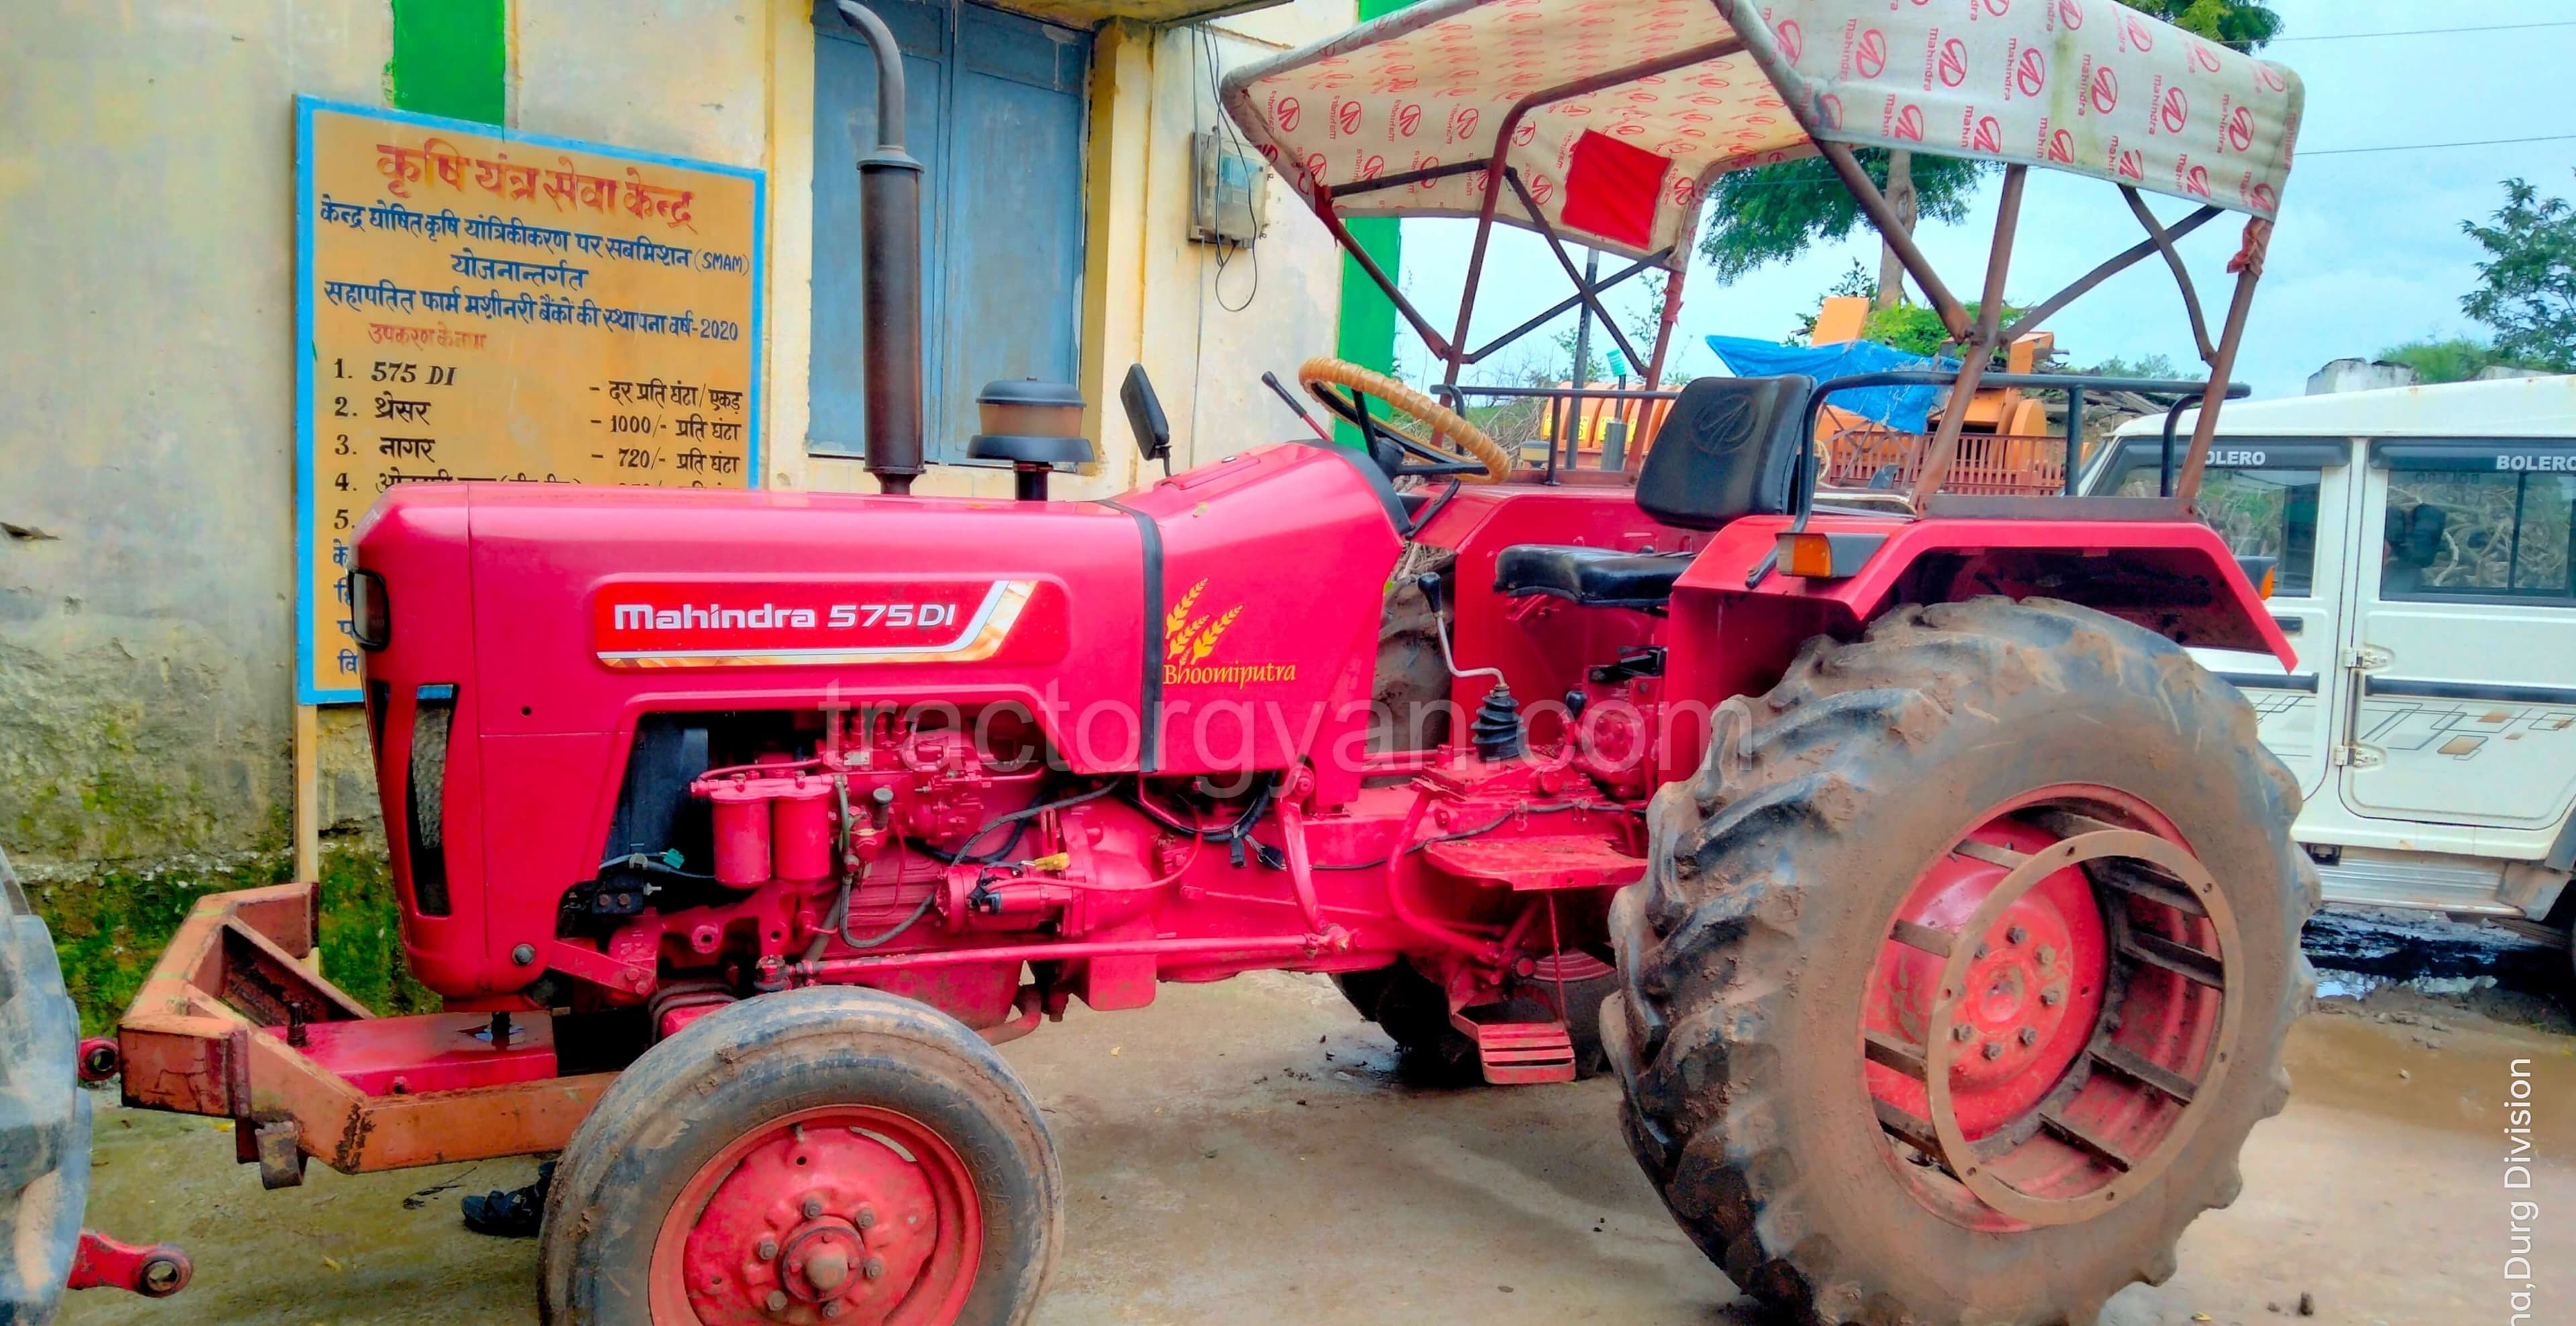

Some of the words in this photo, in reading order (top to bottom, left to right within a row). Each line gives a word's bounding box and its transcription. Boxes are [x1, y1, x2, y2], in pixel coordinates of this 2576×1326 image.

[1840, 18, 1857, 82] mahindra
[1924, 28, 1939, 91] mahindra
[2004, 38, 2017, 101] mahindra
[2078, 54, 2091, 116] mahindra
[2149, 74, 2161, 135] mahindra
[1883, 94, 1895, 136] mahin
[1961, 105, 1974, 148] mahin
[2037, 117, 2048, 158] mahin
[2216, 94, 2230, 154] mahindra
[376, 138, 470, 199] कृषि
[476, 153, 540, 204] यंत्र
[543, 156, 618, 213] सेवा
[623, 167, 698, 234] केन्द्र
[320, 193, 366, 232] केन्द्र
[369, 199, 423, 238] घोषित
[425, 209, 460, 242] कृषि
[464, 214, 571, 254] यांत्रिकीकरण
[575, 234, 603, 258] पर
[606, 236, 692, 267] सबमिशन
[694, 248, 749, 276] (SMAM)
[450, 248, 589, 291] योजनान्तर्गत
[420, 286, 461, 314] फार्म
[465, 289, 537, 323] मशीनरी
[577, 299, 601, 327] की
[603, 308, 667, 334] स्थापना
[334, 358, 353, 378] 1.
[371, 361, 417, 383] 575
[424, 365, 458, 386] DI
[608, 380, 633, 406] दर
[637, 378, 667, 409] प्रति
[335, 397, 358, 417] 2.
[610, 414, 667, 438] 1000/-
[676, 413, 708, 442] प्रति
[711, 417, 741, 440] घंटा
[335, 434, 357, 455] 3.
[379, 437, 435, 463] नागर
[619, 447, 665, 470] 720/-
[676, 448, 707, 475] प्रति
[710, 451, 740, 474] घंटा
[2205, 451, 2266, 465] OLERO
[335, 472, 357, 492] 4.
[333, 509, 356, 529] 5.
[614, 603, 814, 629] Mahindra
[1163, 660, 1295, 690] Bhoomiputra
